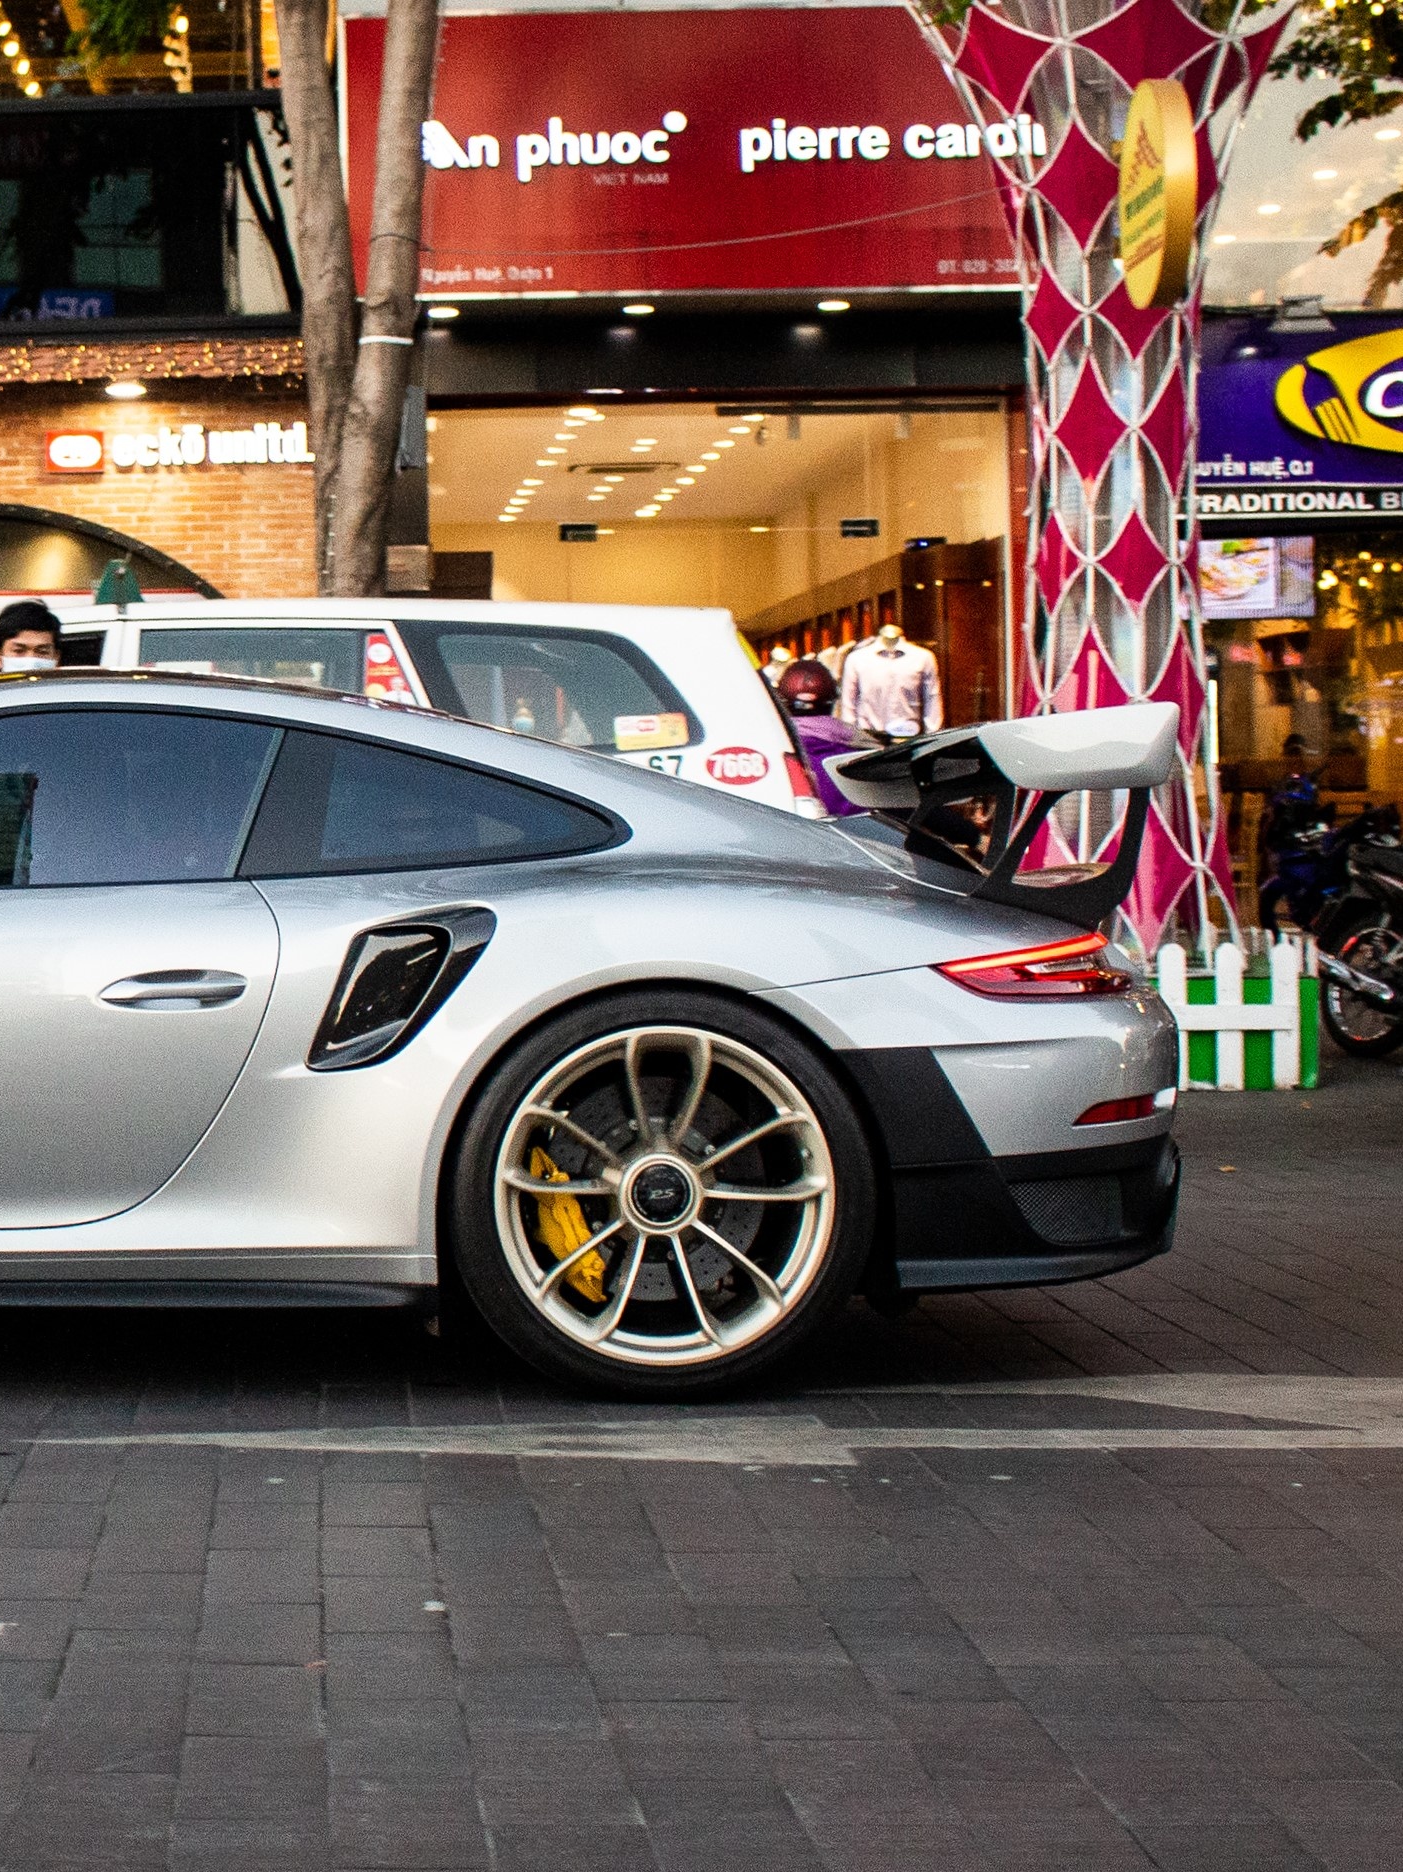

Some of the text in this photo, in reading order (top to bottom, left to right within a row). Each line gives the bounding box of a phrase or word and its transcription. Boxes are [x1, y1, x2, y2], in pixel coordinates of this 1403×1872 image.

[515, 115, 671, 183] phuoc
[740, 117, 891, 173] pierre
[1380, 491, 1403, 510] B
[708, 752, 766, 779] 7668
